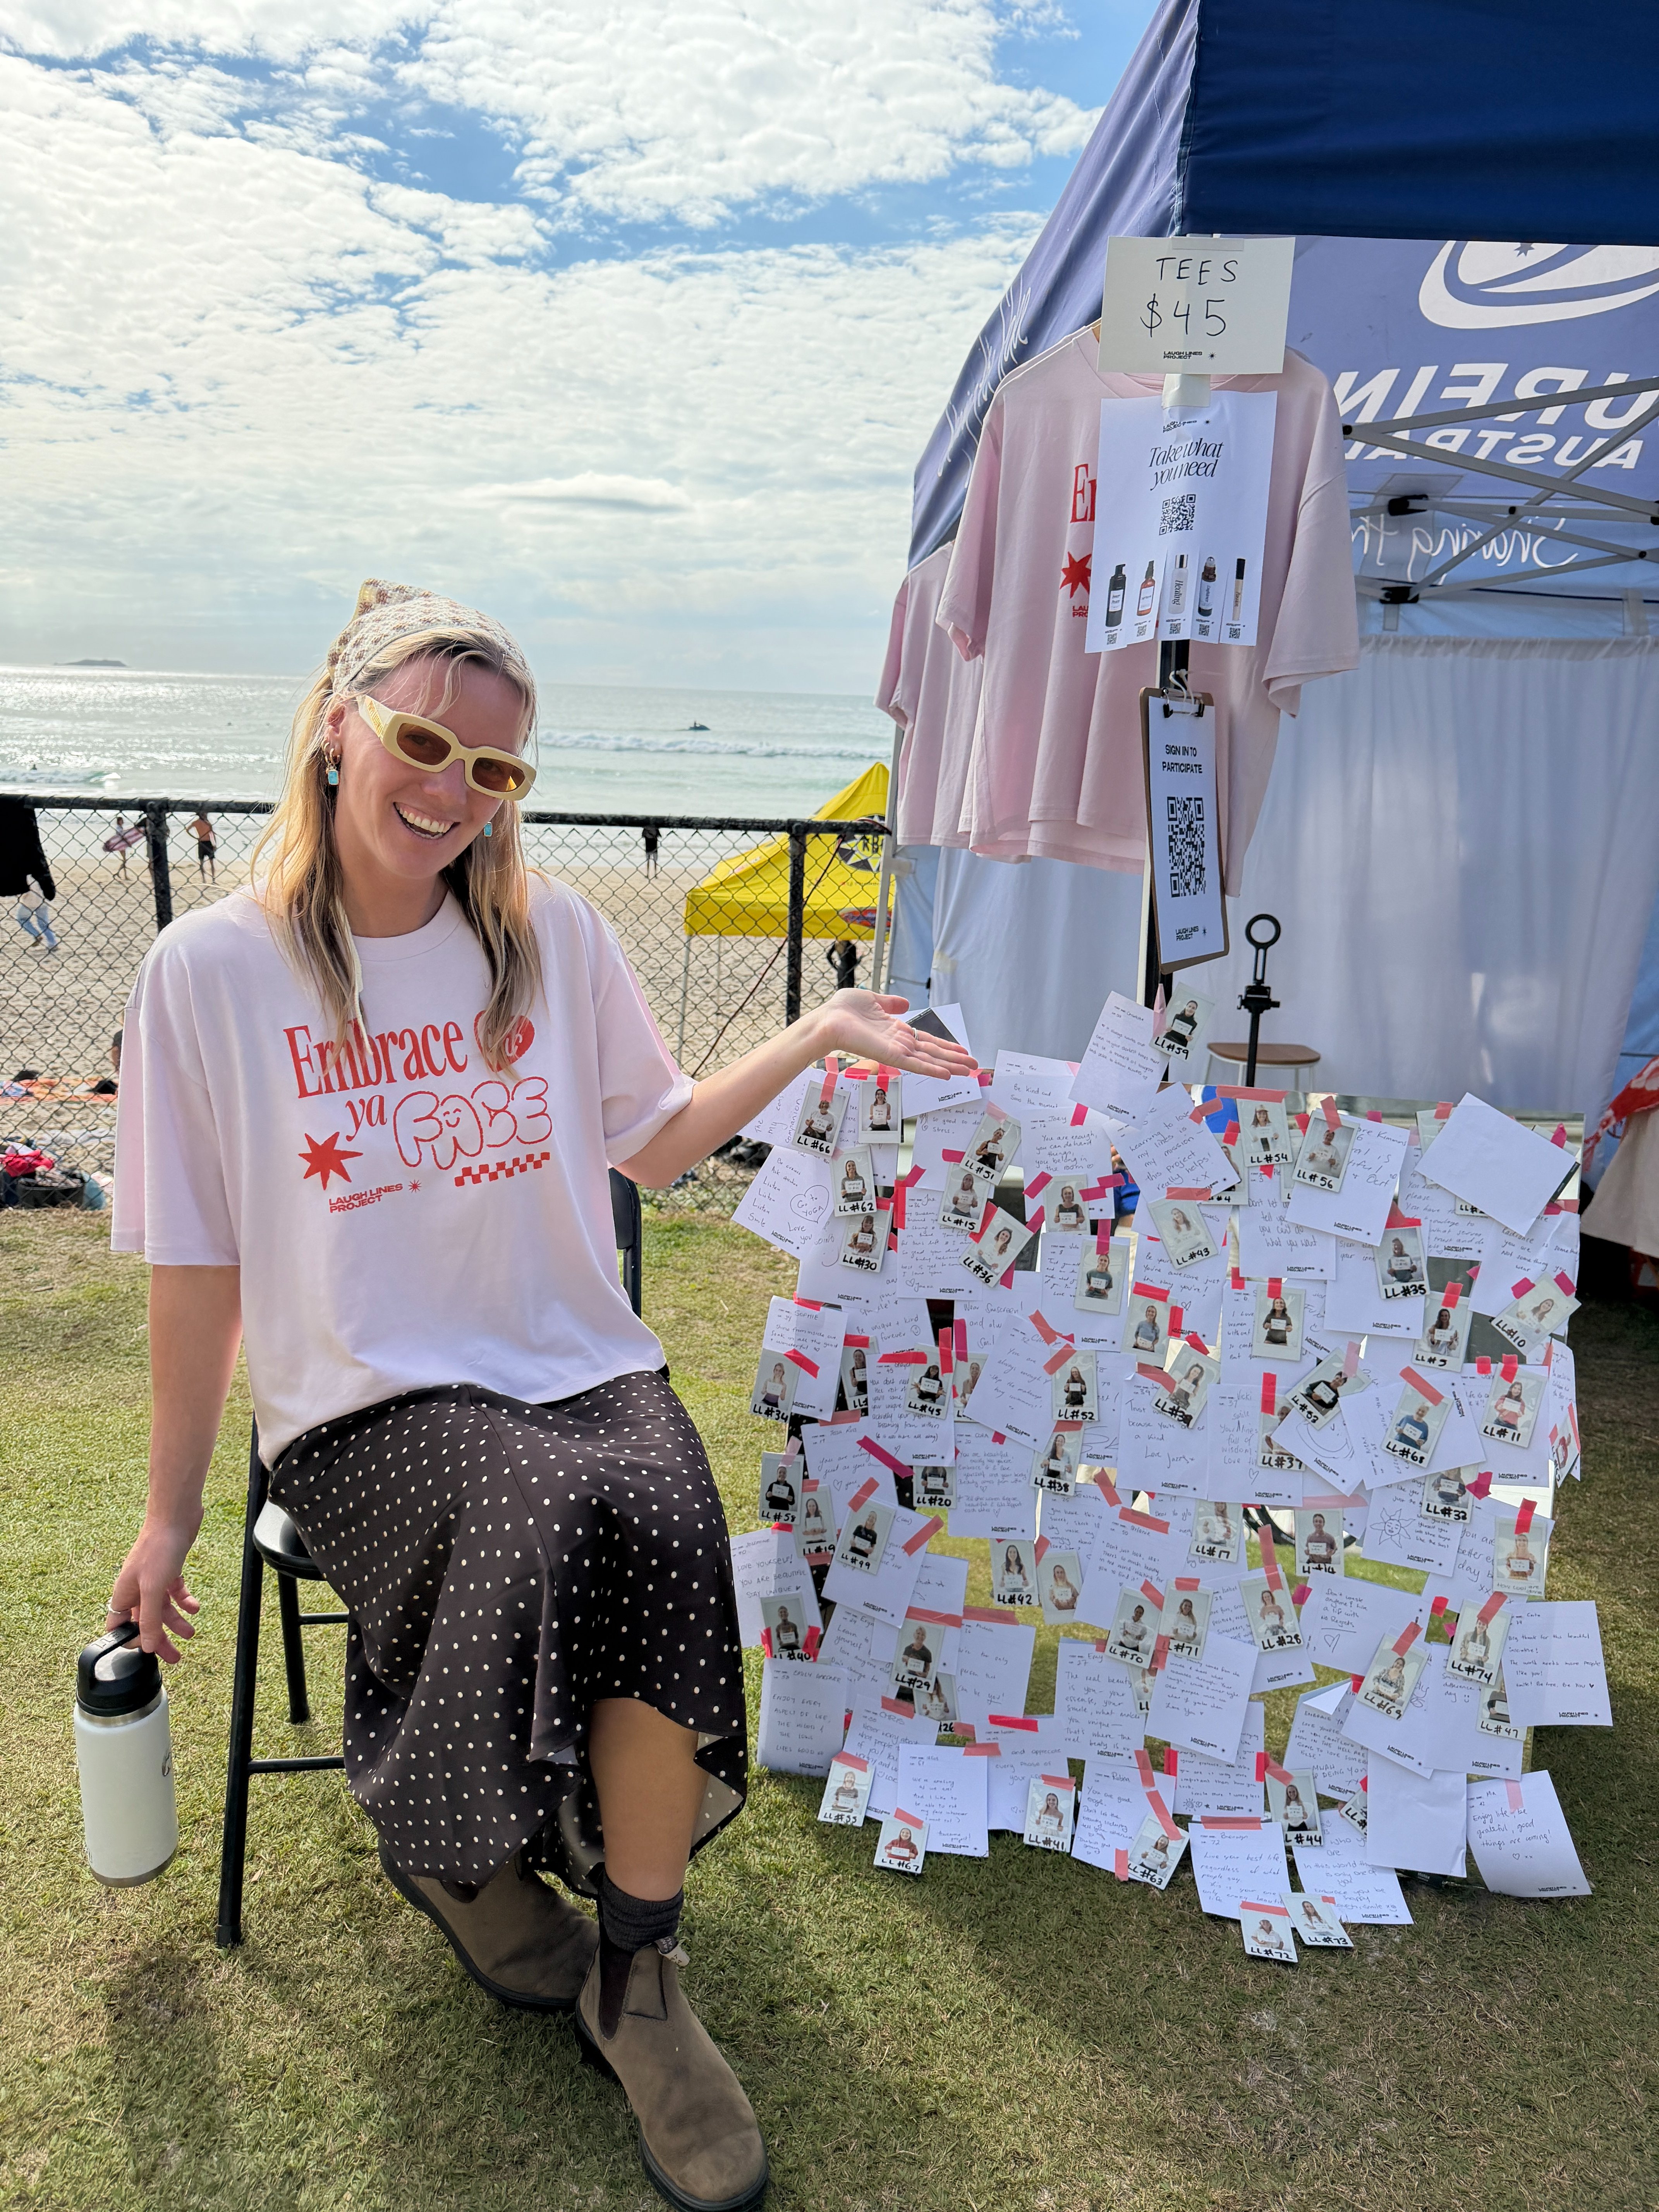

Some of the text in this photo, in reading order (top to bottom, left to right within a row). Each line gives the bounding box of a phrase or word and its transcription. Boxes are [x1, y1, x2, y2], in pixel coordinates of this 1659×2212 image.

[1156, 257, 1238, 285] TEES
[1140, 293, 1226, 338] $45
[1148, 438, 1224, 467] Take what
[1150, 459, 1218, 491] you need
[1171, 580, 1183, 605] Healing
[1165, 744, 1197, 757] SIGN IN TO
[1163, 761, 1202, 774] PARTICIPATE
[283, 1018, 468, 1098] Embrace
[345, 1094, 387, 1141] ya
[1166, 1151, 1196, 1173] project
[329, 1183, 403, 1206] LAUGH LINES
[330, 1194, 382, 1213] PROJECT
